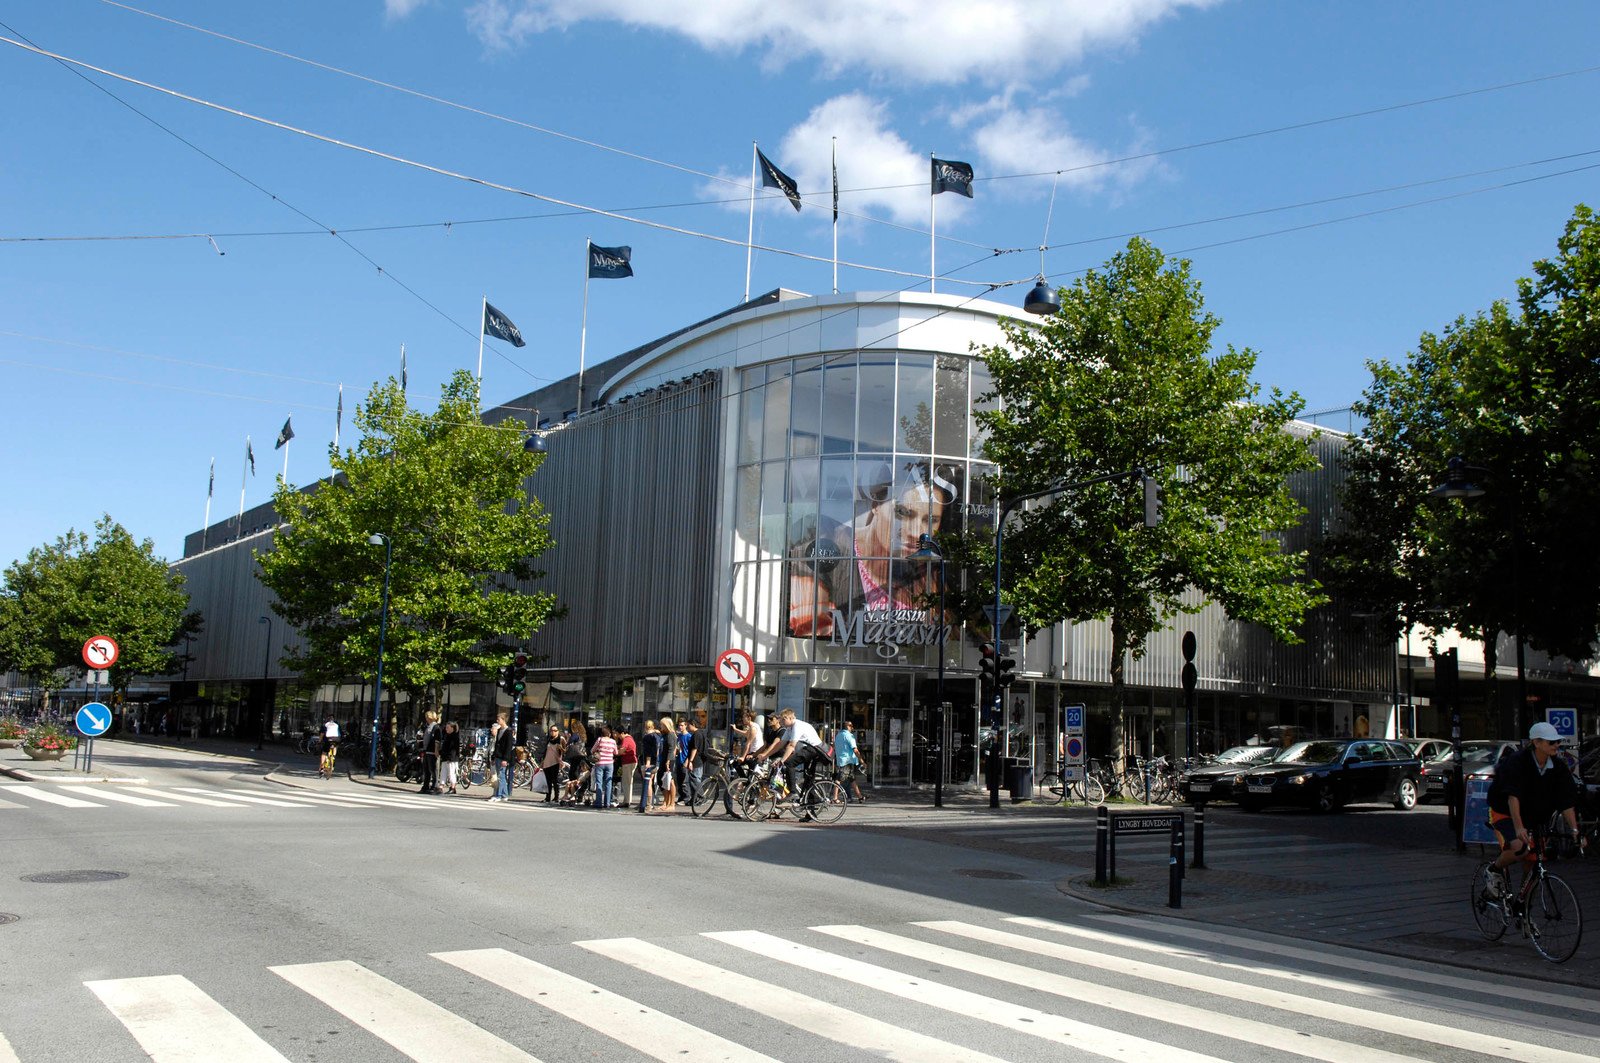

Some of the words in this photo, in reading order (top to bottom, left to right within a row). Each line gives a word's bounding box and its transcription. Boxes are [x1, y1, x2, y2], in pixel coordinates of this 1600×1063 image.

[826, 609, 952, 659] Magasin
[1068, 712, 1080, 722] 20
[1552, 716, 1571, 728] 20
[1118, 820, 1141, 829] LYNGBY
[1141, 819, 1172, 828] HOVEDGA
